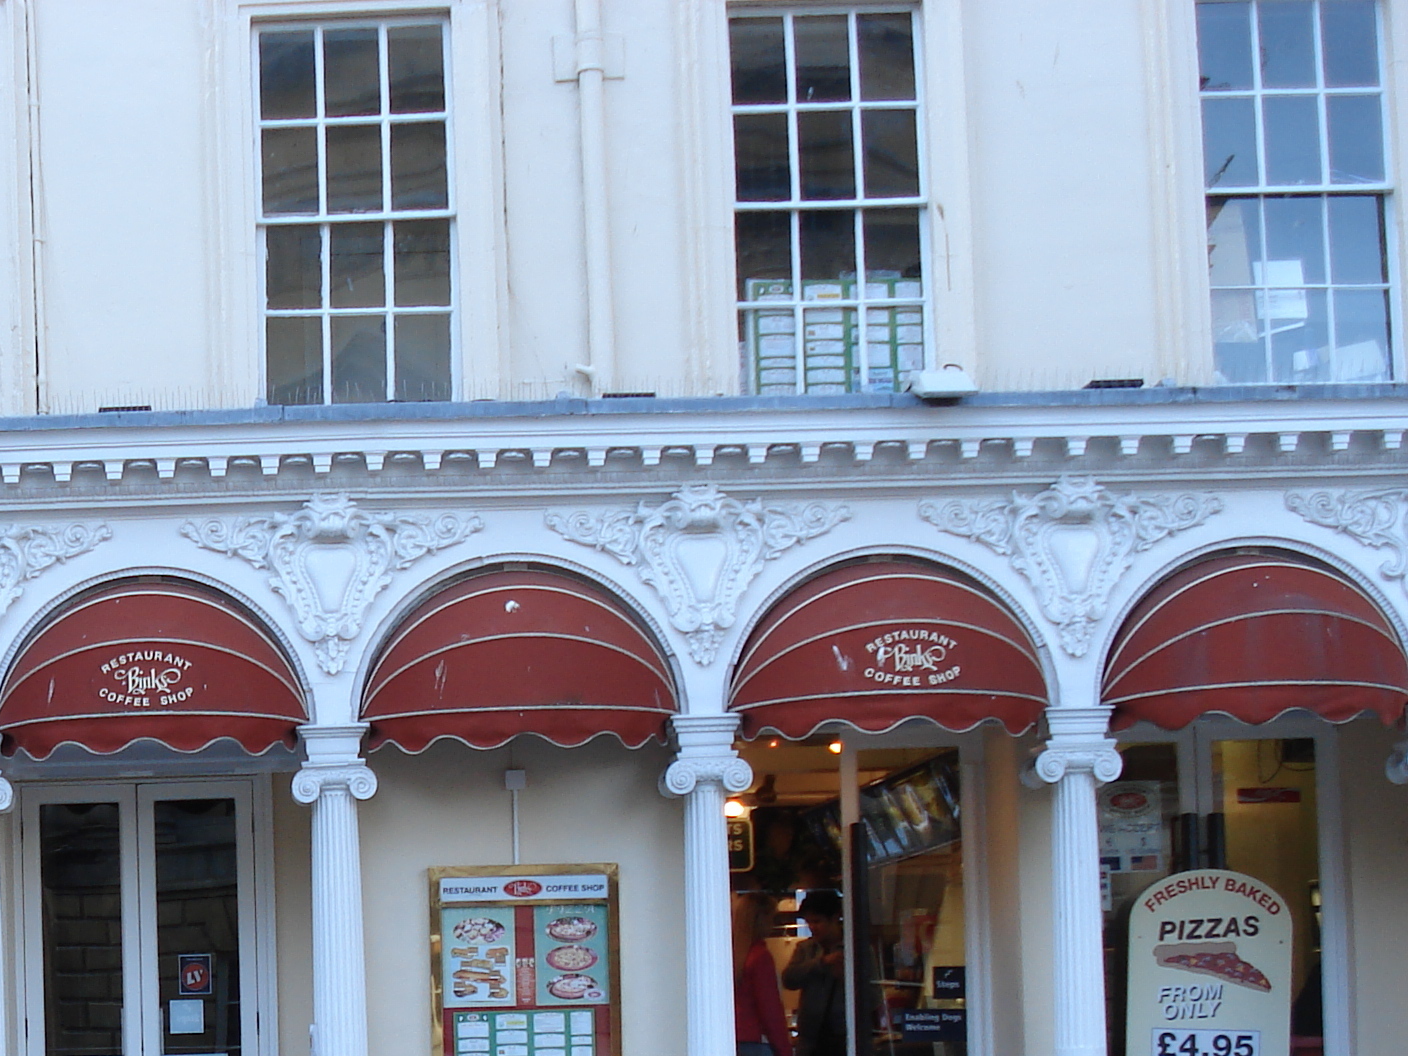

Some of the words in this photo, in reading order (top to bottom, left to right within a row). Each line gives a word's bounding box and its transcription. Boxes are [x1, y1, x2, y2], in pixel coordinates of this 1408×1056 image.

[865, 630, 958, 652] RESTAURANT
[101, 651, 192, 674] RESTAURANT
[114, 666, 181, 694] Binks
[864, 668, 920, 686] COFFEE
[928, 666, 960, 685] SHOP
[99, 688, 150, 706] COFFEE
[160, 688, 193, 705] SHOP
[442, 886, 498, 894] RESTAURANT
[582, 884, 604, 892] SHOP
[1144, 876, 1220, 913] FRESHLY
[1224, 879, 1280, 916] BAKED
[1159, 916, 1260, 941] PIZZAS
[1158, 985, 1223, 1003] FROM
[1164, 1002, 1222, 1020] ONLY
